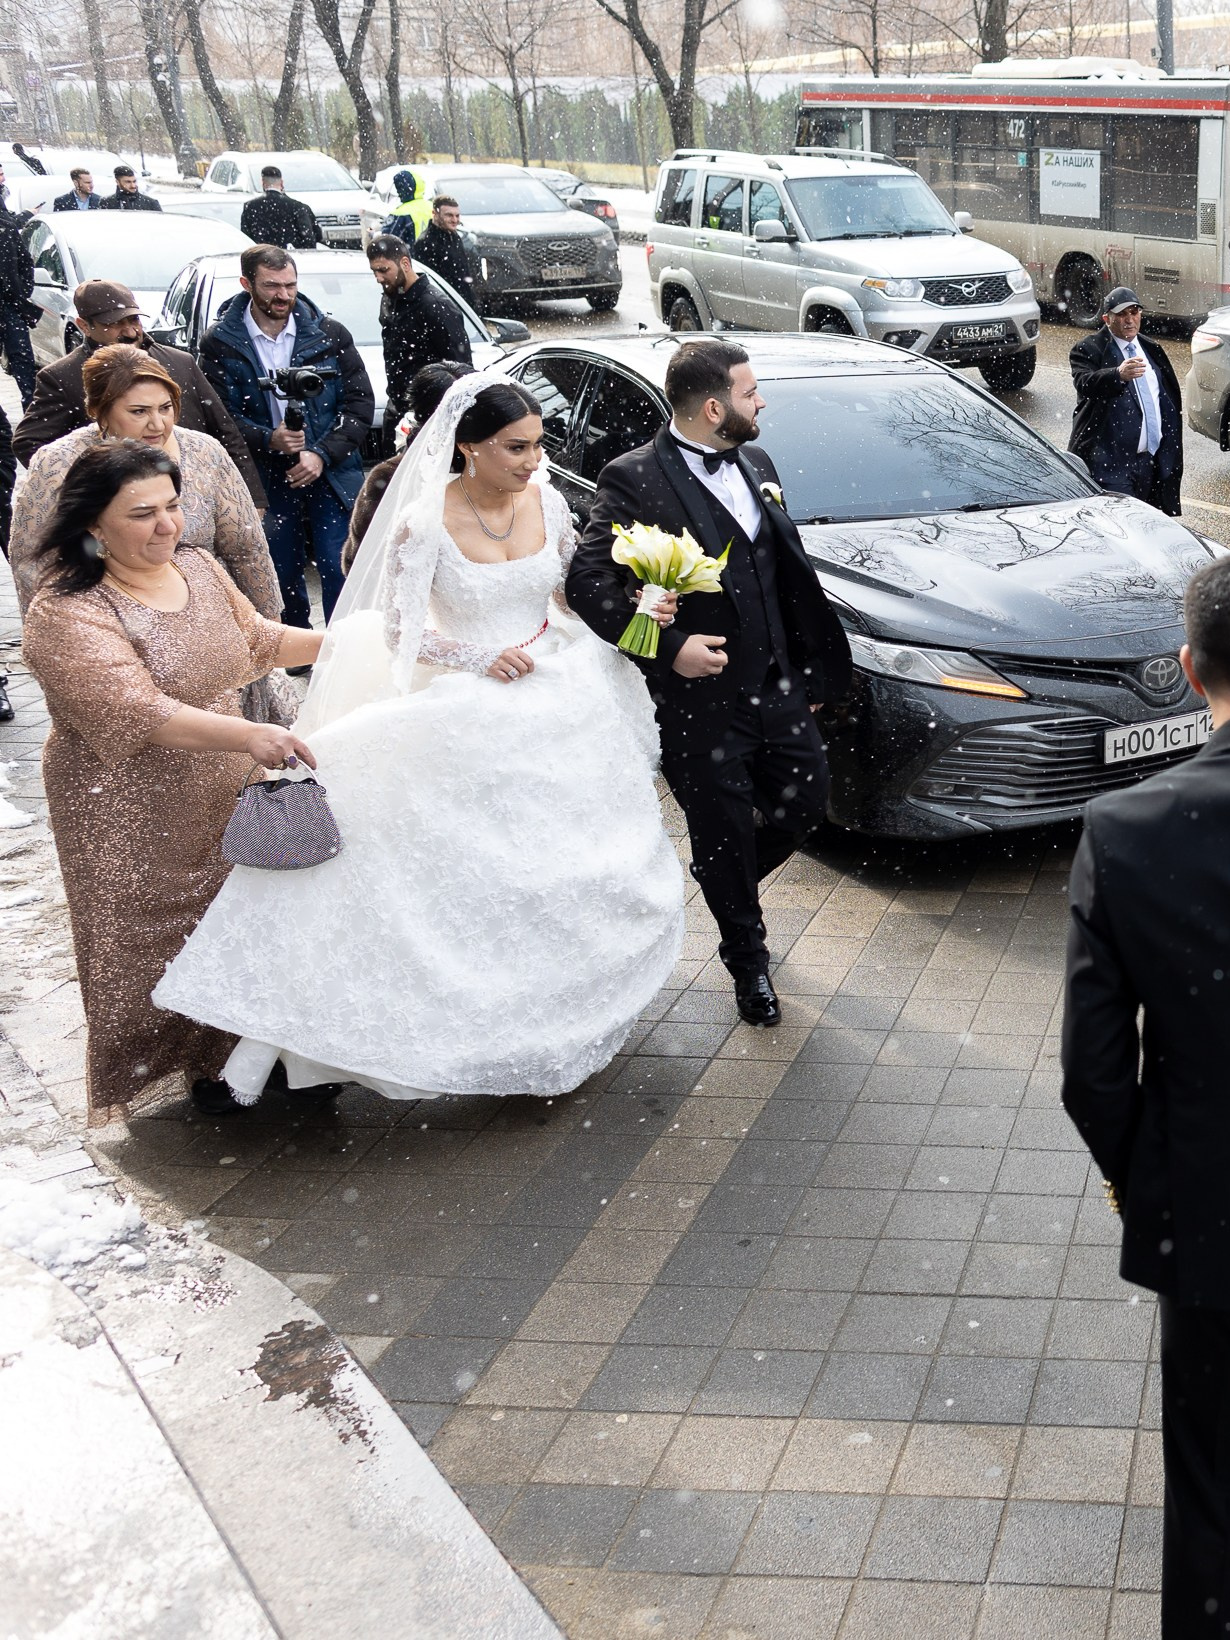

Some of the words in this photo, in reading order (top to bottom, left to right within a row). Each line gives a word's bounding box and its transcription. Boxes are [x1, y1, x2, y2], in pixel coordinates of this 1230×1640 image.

[1008, 119, 1025, 139] 472
[1062, 155, 1095, 168] НАШИХ
[1113, 723, 1195, 759] Н001СТ
